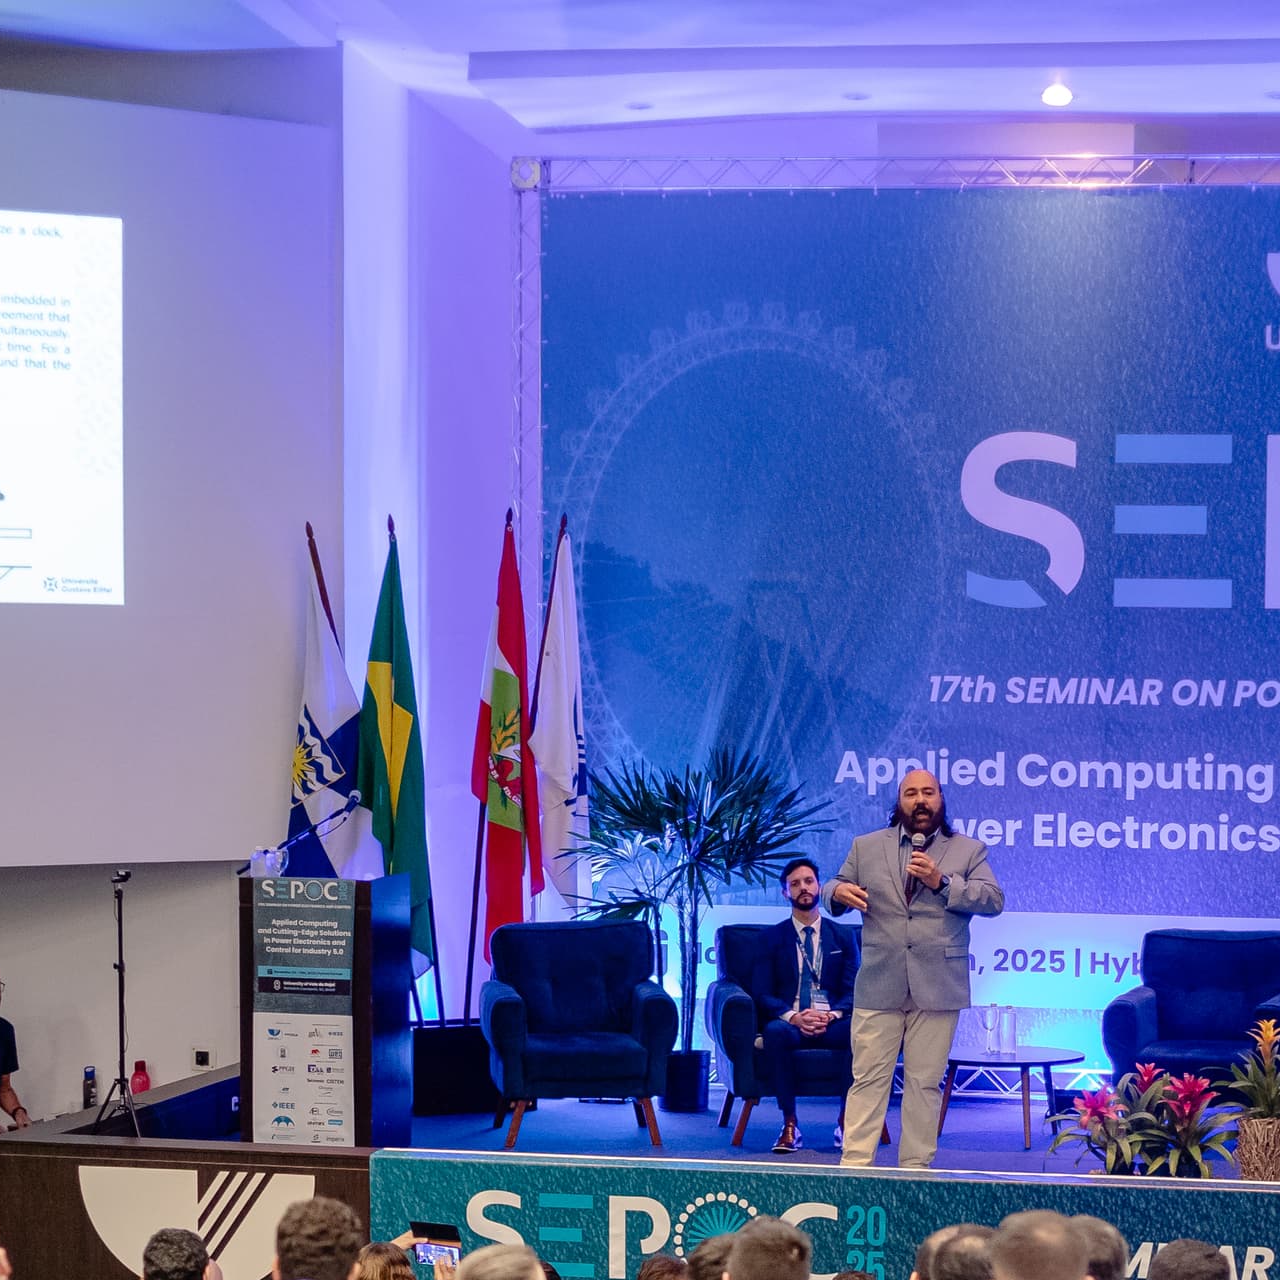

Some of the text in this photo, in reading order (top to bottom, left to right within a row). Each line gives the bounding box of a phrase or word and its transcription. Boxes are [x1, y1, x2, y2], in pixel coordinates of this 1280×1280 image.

[928, 674, 997, 704] 17th
[1005, 676, 1161, 706] SEMINAR
[1171, 679, 1224, 708] ON
[1017, 751, 1276, 804] Computing
[952, 817, 1023, 847] wer
[1032, 812, 1280, 853] Electronics
[261, 879, 338, 901] SEPOC
[271, 919, 338, 928] Applied Computing
[272, 928, 319, 937] Cutting-Edge
[319, 929, 352, 937] Solutions
[265, 946, 291, 954] Control
[292, 946, 302, 954] for
[302, 947, 332, 956] Industry
[293, 938, 331, 946] Electronics
[992, 947, 1066, 974] 2025
[846, 1204, 887, 1247] 20
